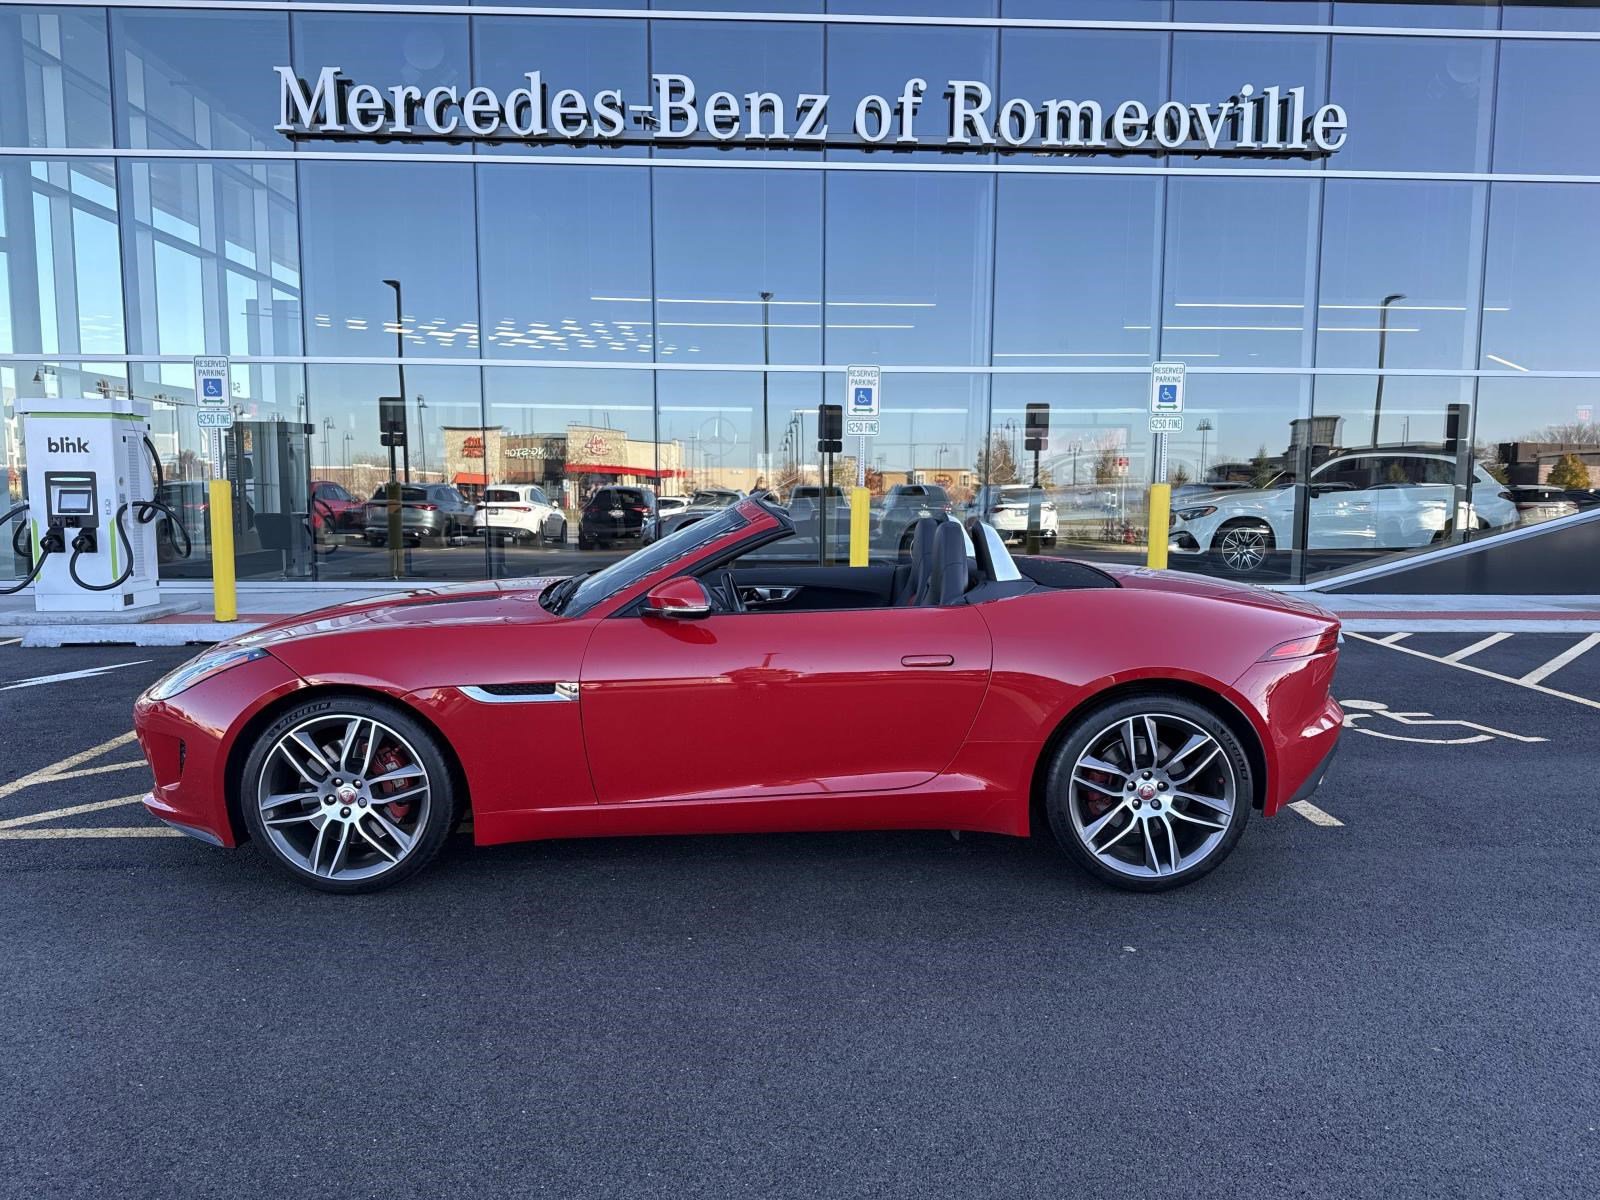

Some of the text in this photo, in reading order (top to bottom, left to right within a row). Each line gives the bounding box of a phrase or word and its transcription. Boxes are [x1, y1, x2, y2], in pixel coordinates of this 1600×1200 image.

[273, 66, 1348, 151] Mercedes-Benz of Romeoville
[195, 360, 227, 368] RESERVED
[198, 369, 226, 377] PARKING
[1154, 367, 1184, 375] RESERVED
[850, 378, 877, 386] PARKING
[1155, 375, 1181, 383] PARKING
[198, 414, 230, 424] $250 FINE
[1152, 419, 1181, 429] $250 FINE
[848, 422, 878, 432] $250 FINE
[47, 437, 90, 453] blink
[279, 702, 329, 729] MICHELIN
